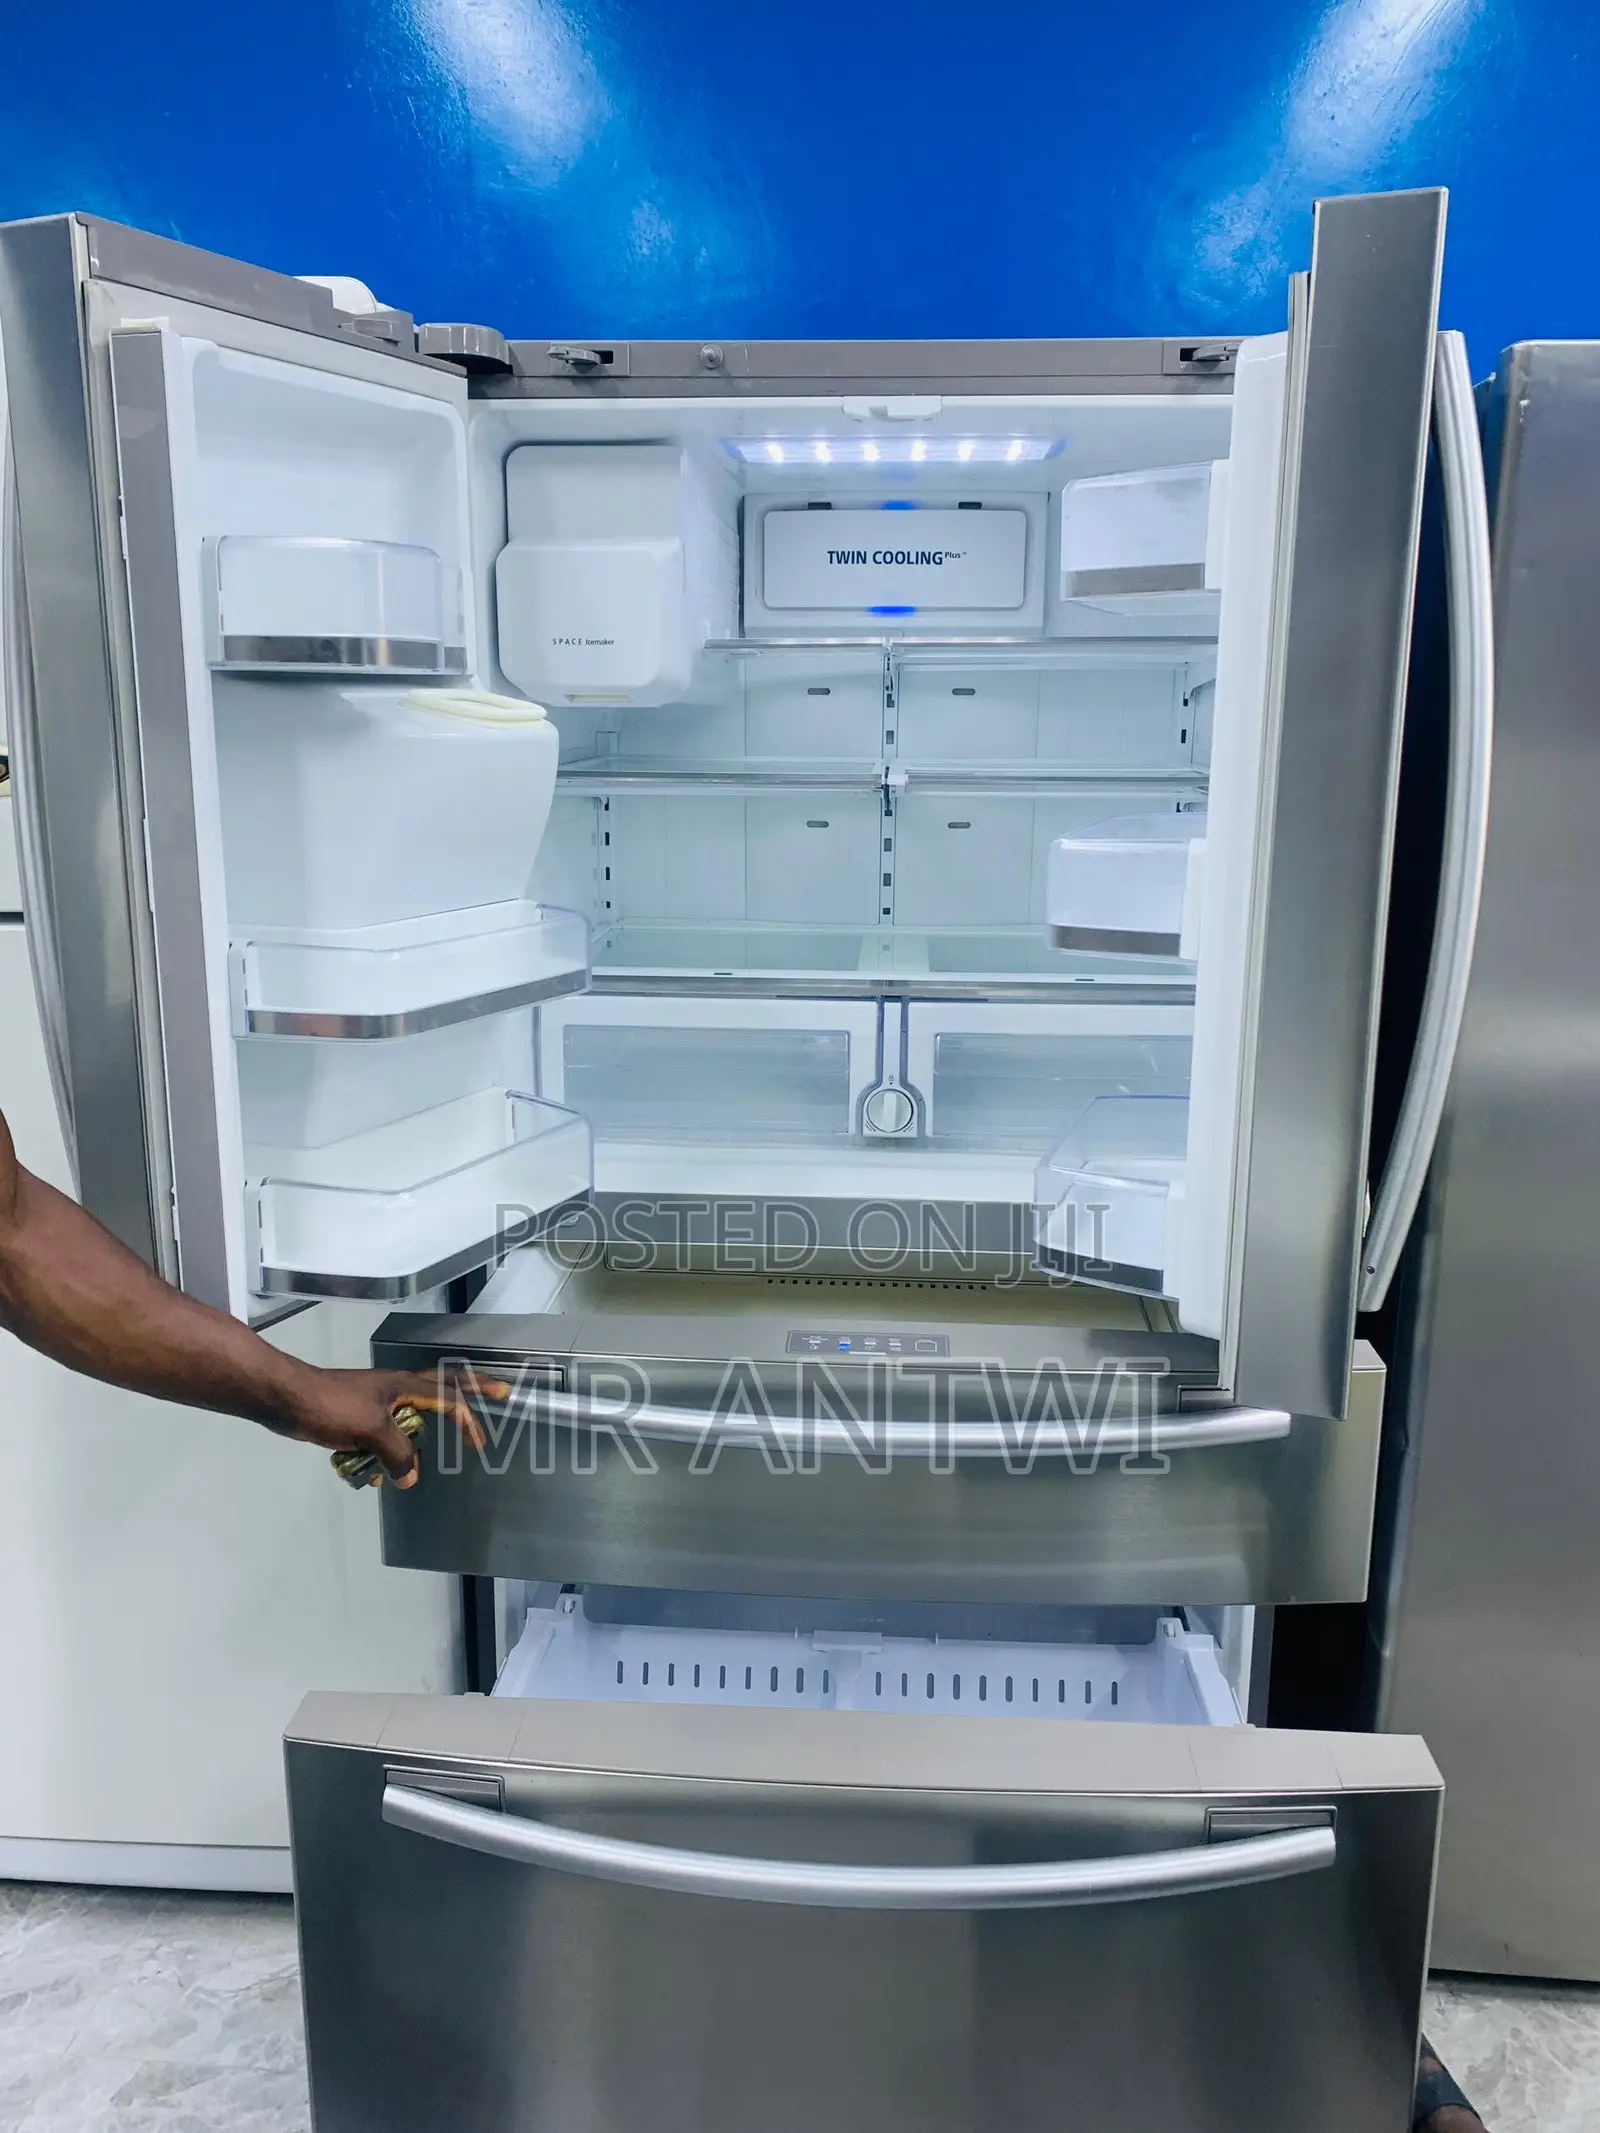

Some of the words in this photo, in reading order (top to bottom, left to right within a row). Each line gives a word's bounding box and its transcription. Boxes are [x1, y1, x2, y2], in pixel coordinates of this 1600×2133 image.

[826, 550, 867, 565] TWIN
[872, 550, 943, 565] COOLING
[585, 638, 615, 646] Icemaker
